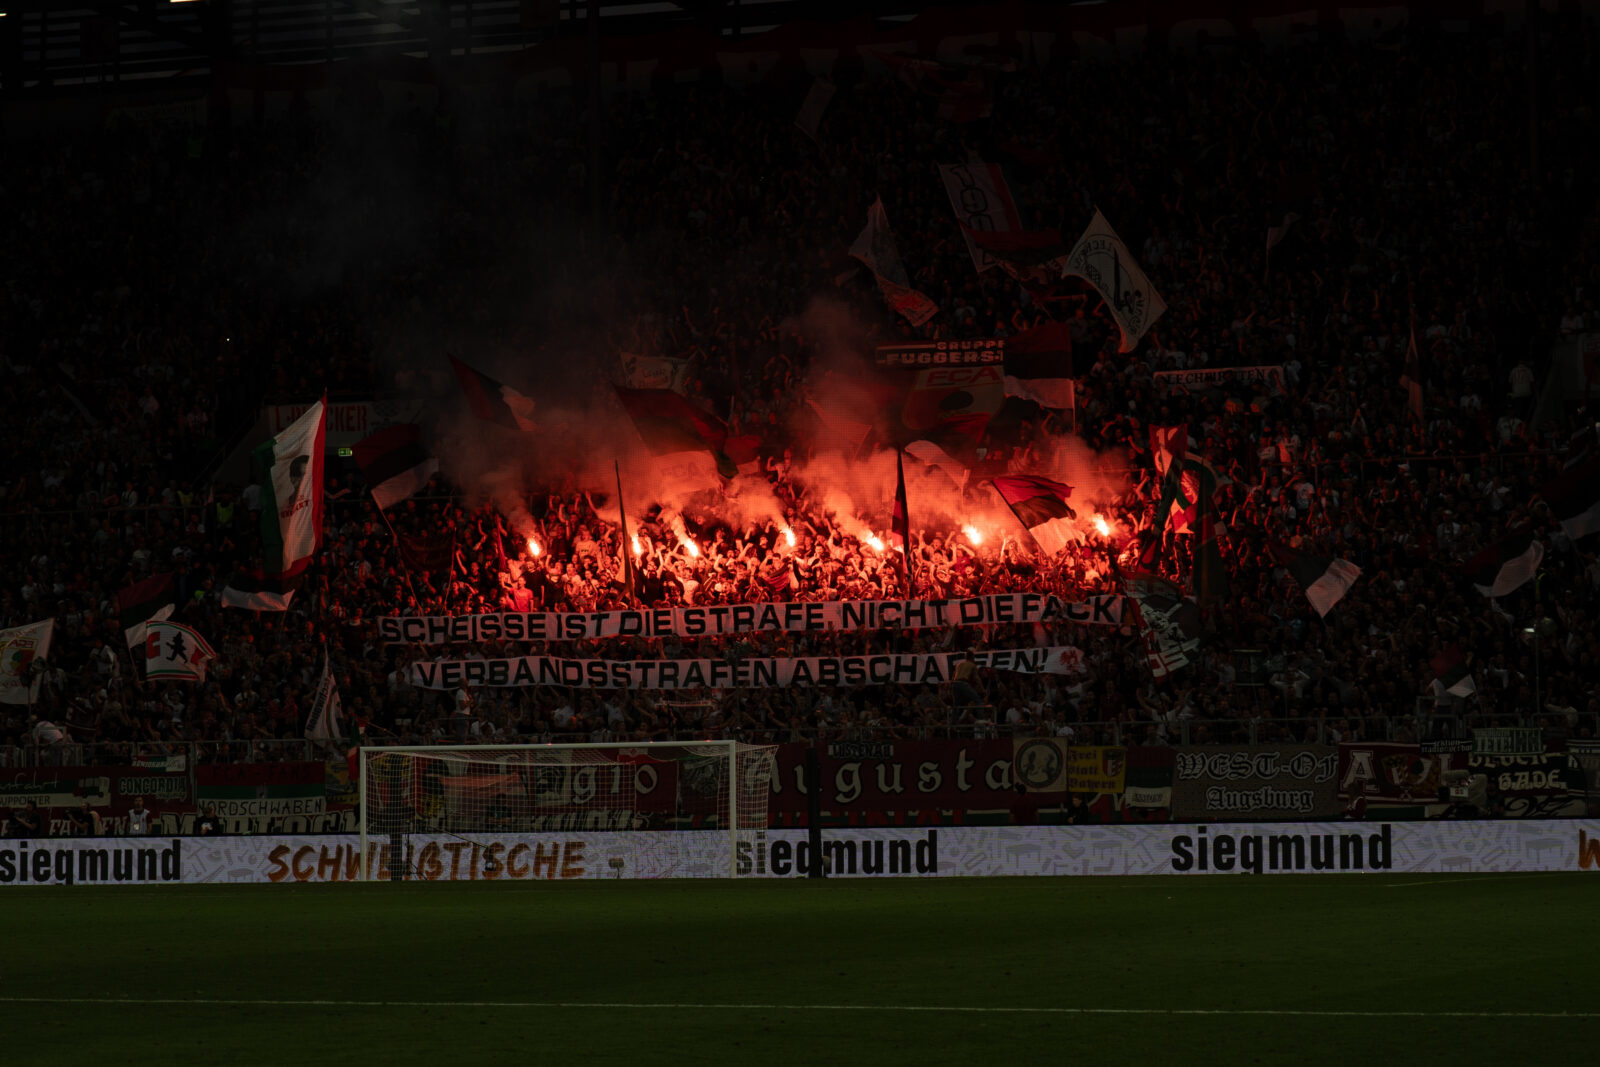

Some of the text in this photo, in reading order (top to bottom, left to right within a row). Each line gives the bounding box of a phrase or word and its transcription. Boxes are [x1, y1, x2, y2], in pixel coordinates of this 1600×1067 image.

[926, 366, 1001, 386] FCA
[381, 612, 548, 643] SCHEISSE
[556, 612, 610, 640] IST
[618, 608, 673, 637] DIE
[683, 602, 825, 637] STRAFE
[842, 599, 948, 630] NICHT
[960, 594, 1015, 625] DIE
[416, 656, 778, 689] VERBANDSSTRAFEN
[118, 775, 188, 797] CONCORDIA
[1206, 785, 1314, 813] Augsburg
[198, 798, 323, 816] NORDSCHWABEN
[0, 840, 181, 885] siegmund
[1171, 823, 1391, 874] siegmund
